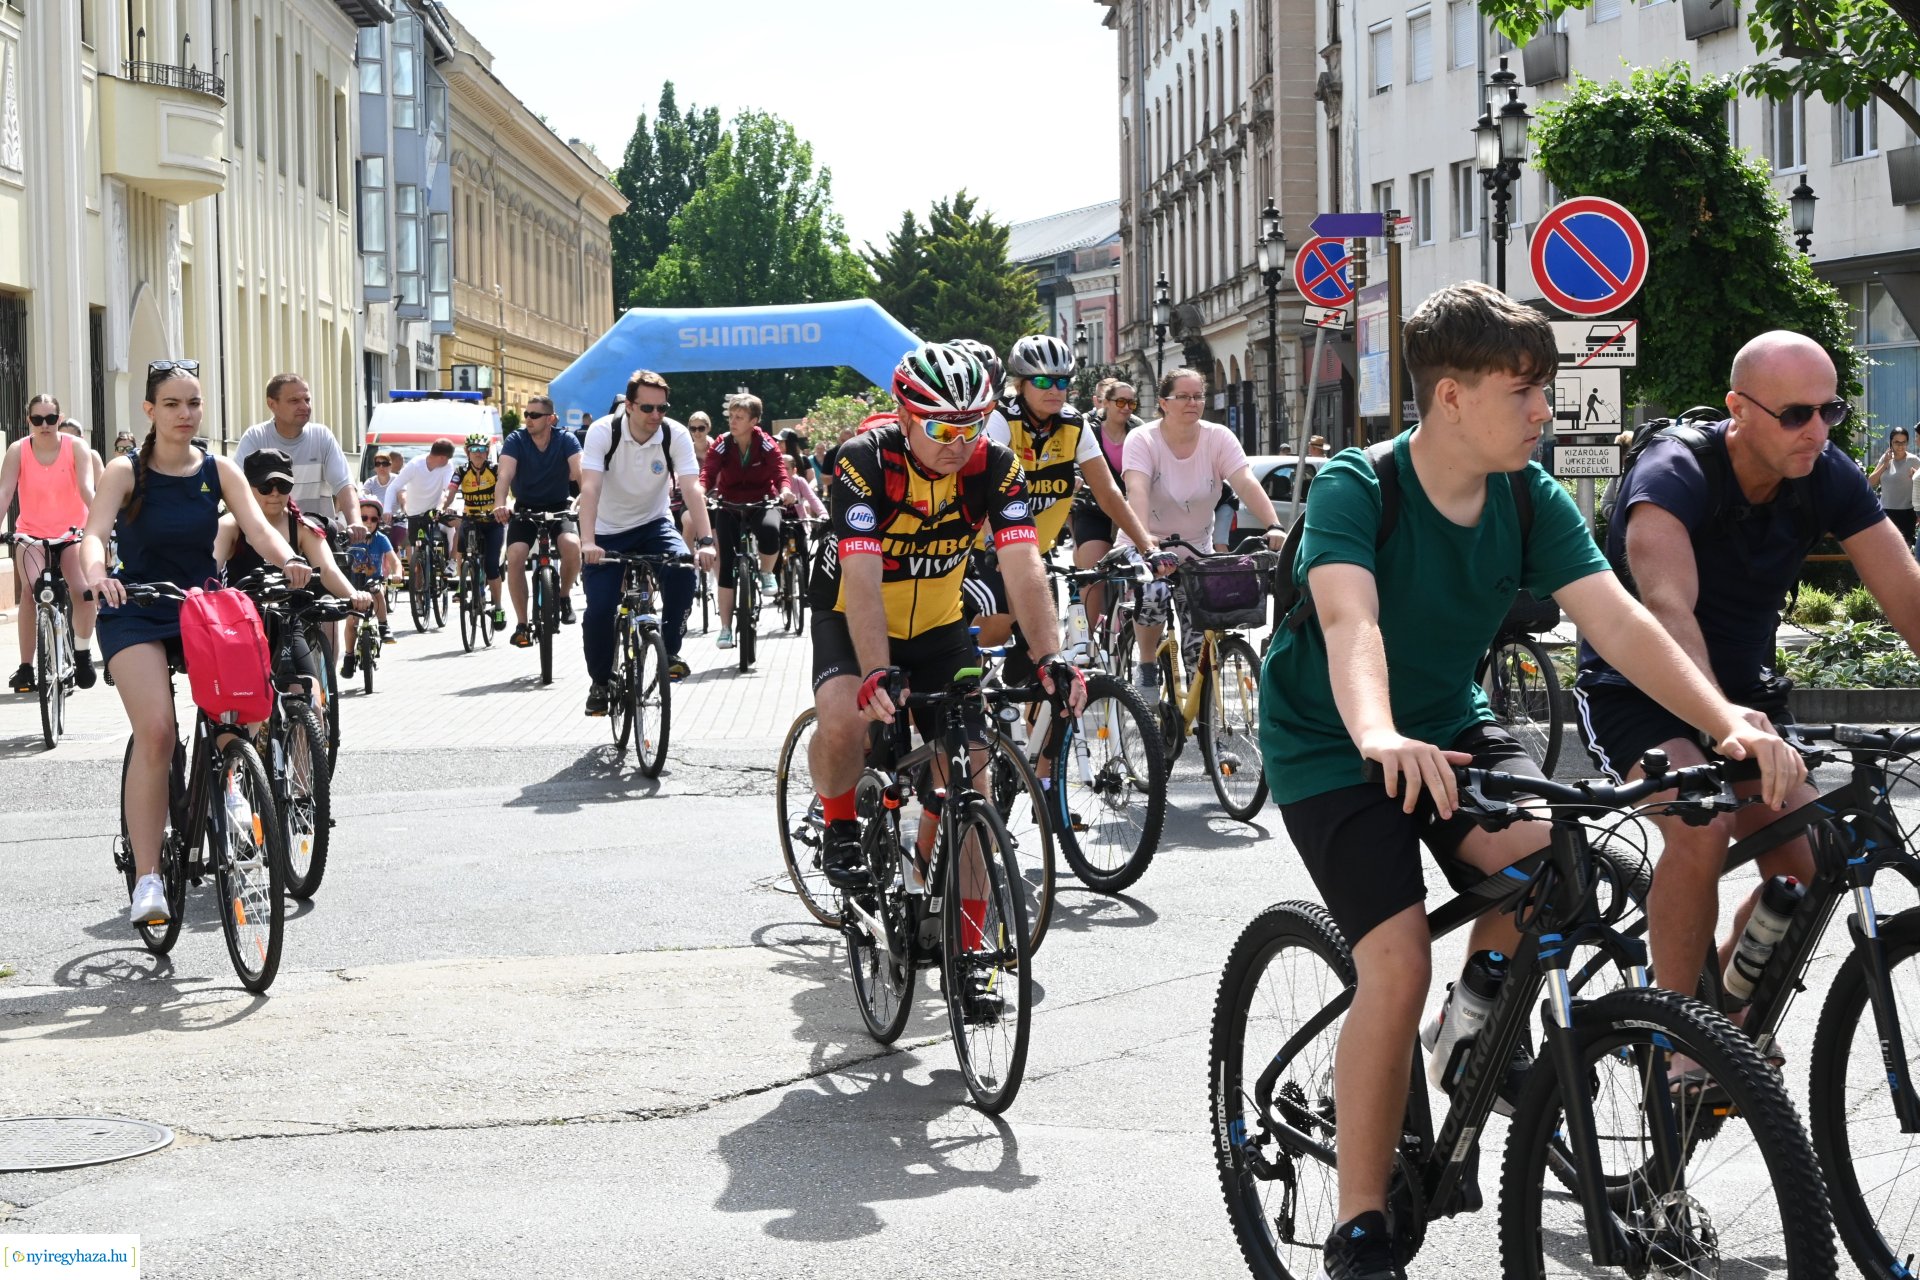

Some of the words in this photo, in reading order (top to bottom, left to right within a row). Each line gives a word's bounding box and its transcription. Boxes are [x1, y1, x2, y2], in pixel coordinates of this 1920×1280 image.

[678, 322, 822, 348] SHIMANO
[1564, 448, 1610, 456] KIZÁRÓLAG
[1560, 465, 1615, 474] ENGEDÉLLYEL
[838, 456, 873, 497] JUMBO
[840, 474, 866, 499] VISMA
[851, 511, 875, 524] Vifit
[1001, 529, 1037, 543] HEMA
[845, 541, 882, 553] HEMA
